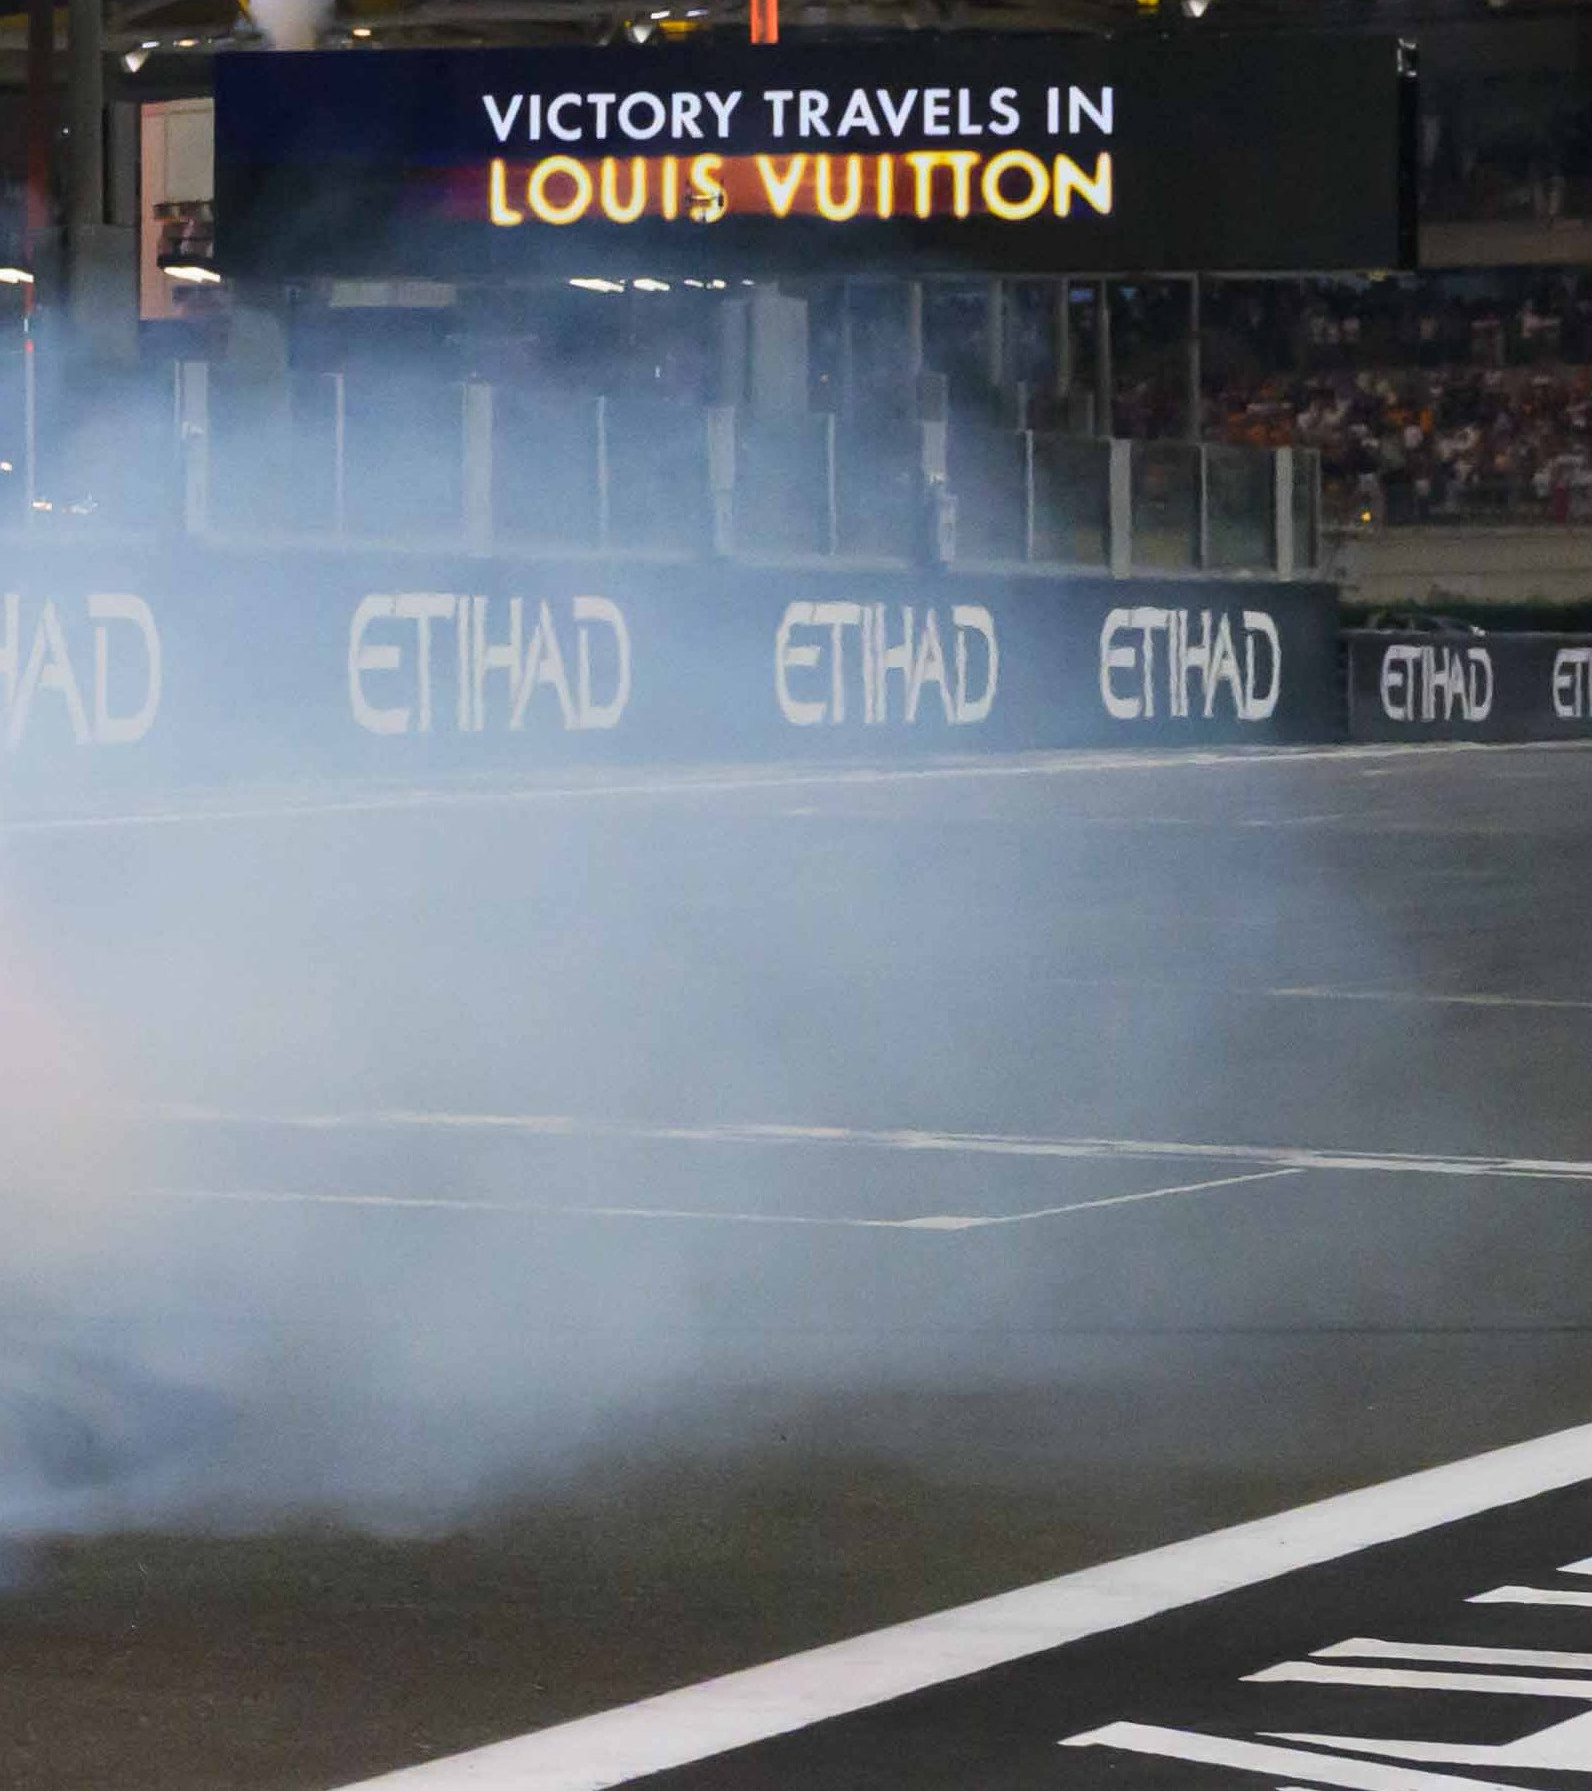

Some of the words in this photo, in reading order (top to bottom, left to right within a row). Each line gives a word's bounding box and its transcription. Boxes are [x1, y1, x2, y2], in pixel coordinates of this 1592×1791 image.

[482, 90, 743, 142] VICTORY
[763, 86, 1021, 139] TRAVELS
[1047, 85, 1115, 135] IN
[488, 152, 728, 227] LOUIS
[750, 149, 1114, 222] VUITTON
[347, 592, 631, 736] ETIHAD
[773, 600, 999, 728] ETIHAD
[1098, 606, 1281, 721] ETIHAD
[1380, 644, 1494, 722] ETIHAD
